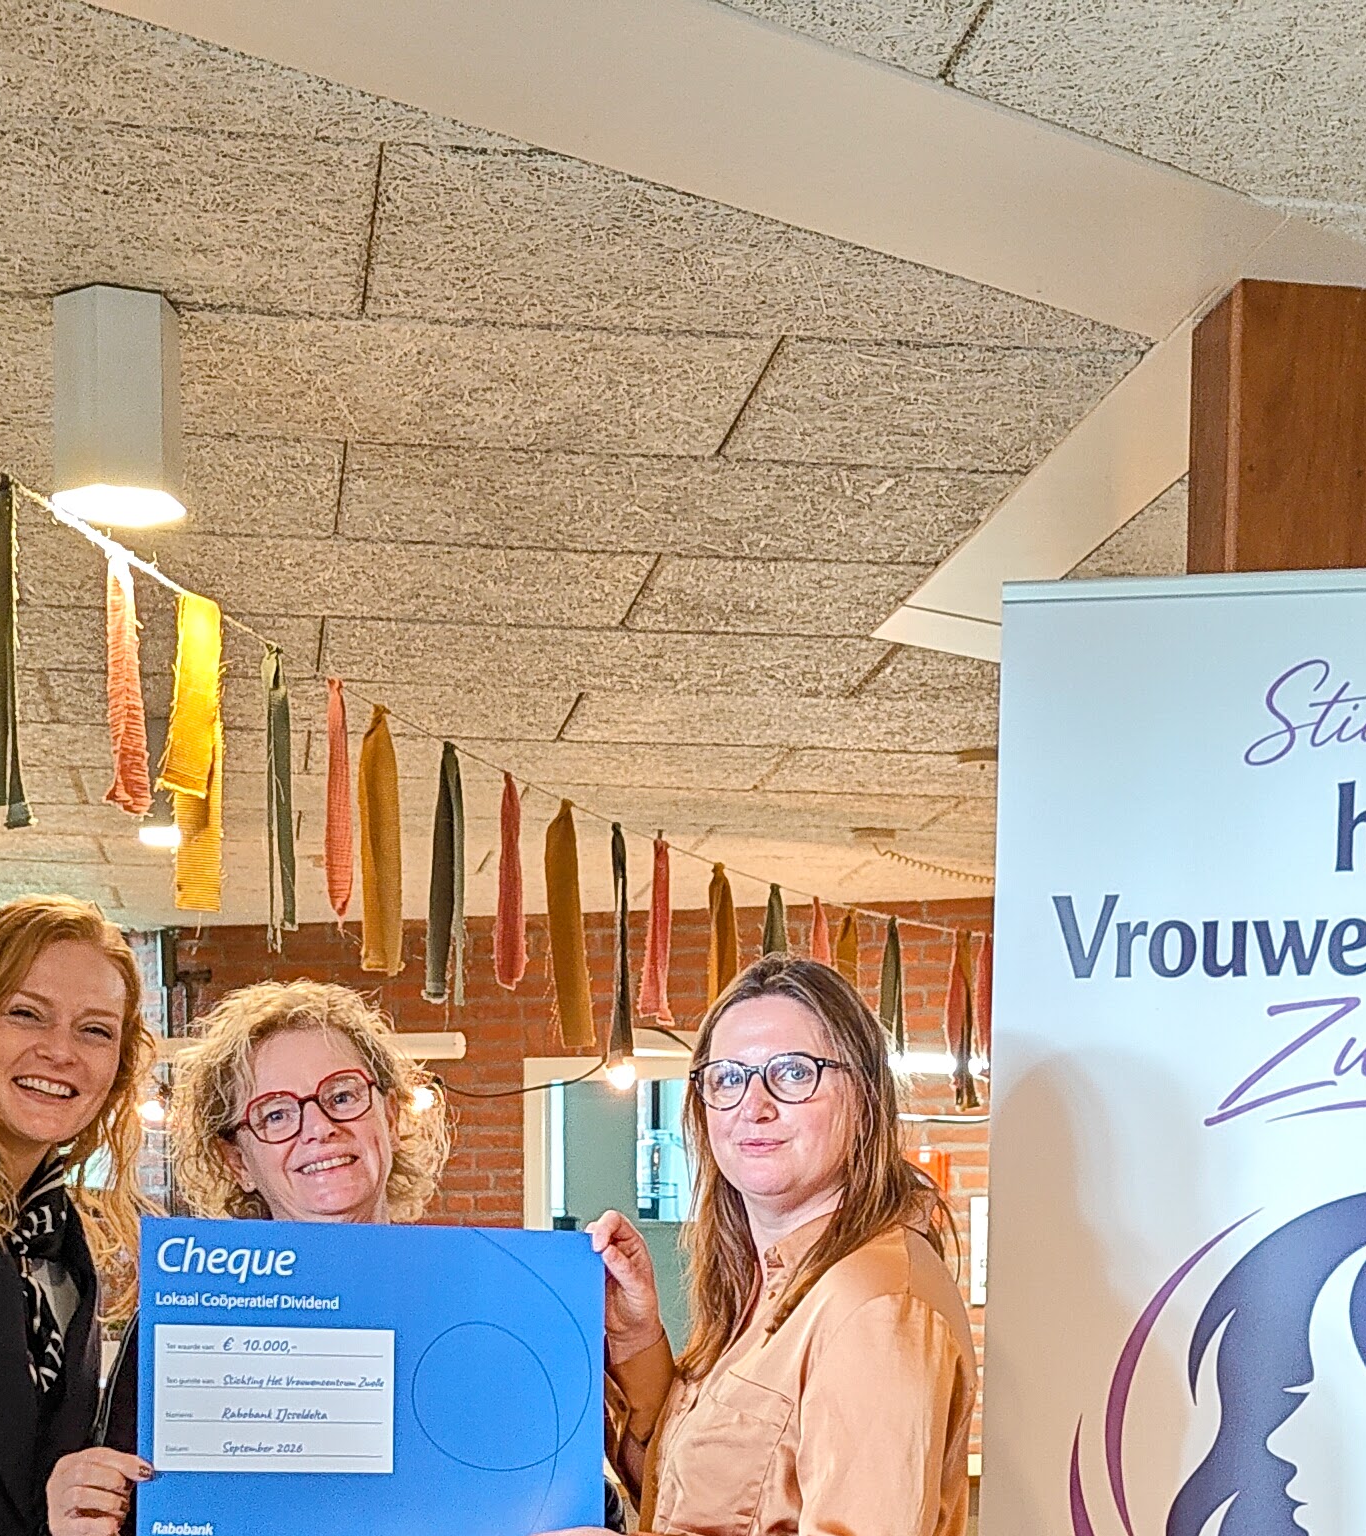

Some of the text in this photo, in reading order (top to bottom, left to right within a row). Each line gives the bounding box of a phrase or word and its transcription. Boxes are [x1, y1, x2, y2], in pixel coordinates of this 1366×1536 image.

[156, 1236, 297, 1284] Cheque
[154, 1291, 340, 1311] Lokaal Coöperatief Dividend
[222, 1336, 235, 1352] €
[222, 1373, 264, 1388] Stichting
[265, 1375, 283, 1387] Het
[221, 1407, 273, 1420] Rabobank
[221, 1441, 274, 1456] September
[151, 1521, 214, 1536] Rabobank
